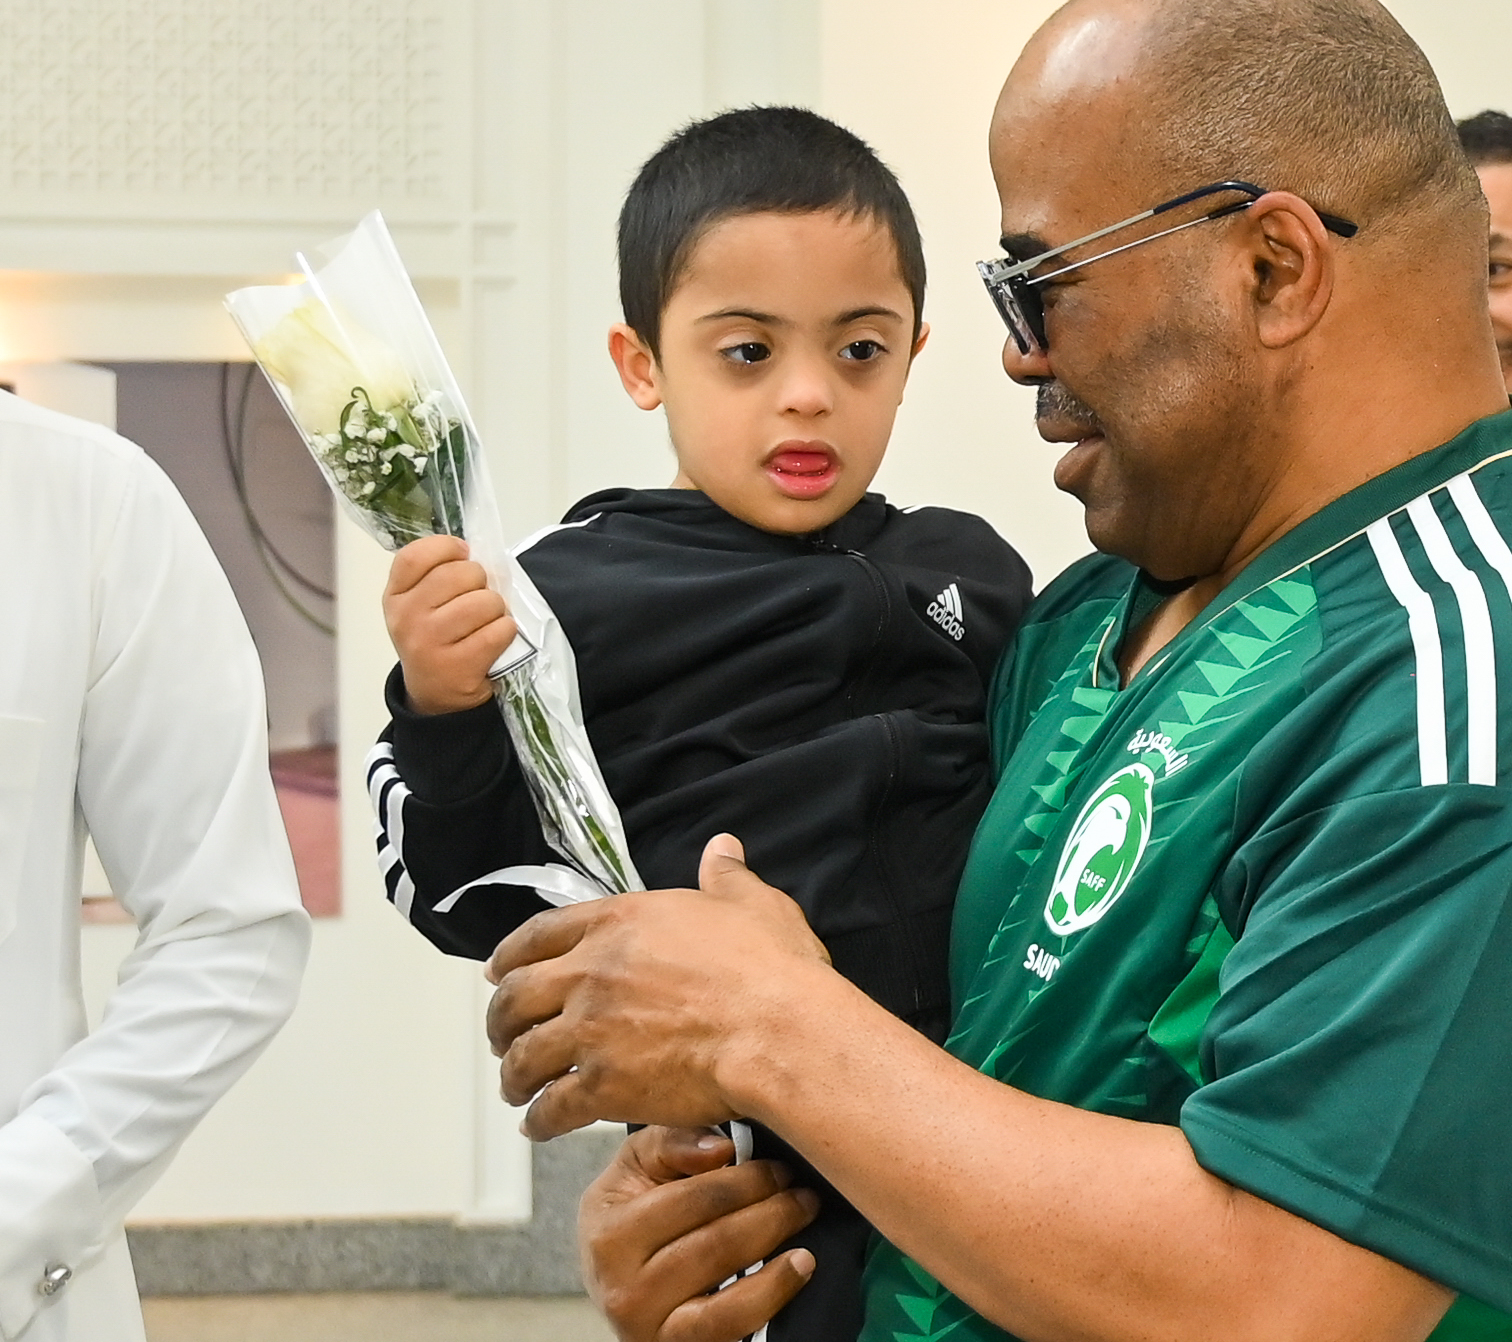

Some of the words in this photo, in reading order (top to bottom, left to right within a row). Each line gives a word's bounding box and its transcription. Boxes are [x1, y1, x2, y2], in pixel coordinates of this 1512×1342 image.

[926, 601, 965, 641] adidas
[1127, 728, 1189, 777] السعودية
[1080, 868, 1107, 892] SAFF
